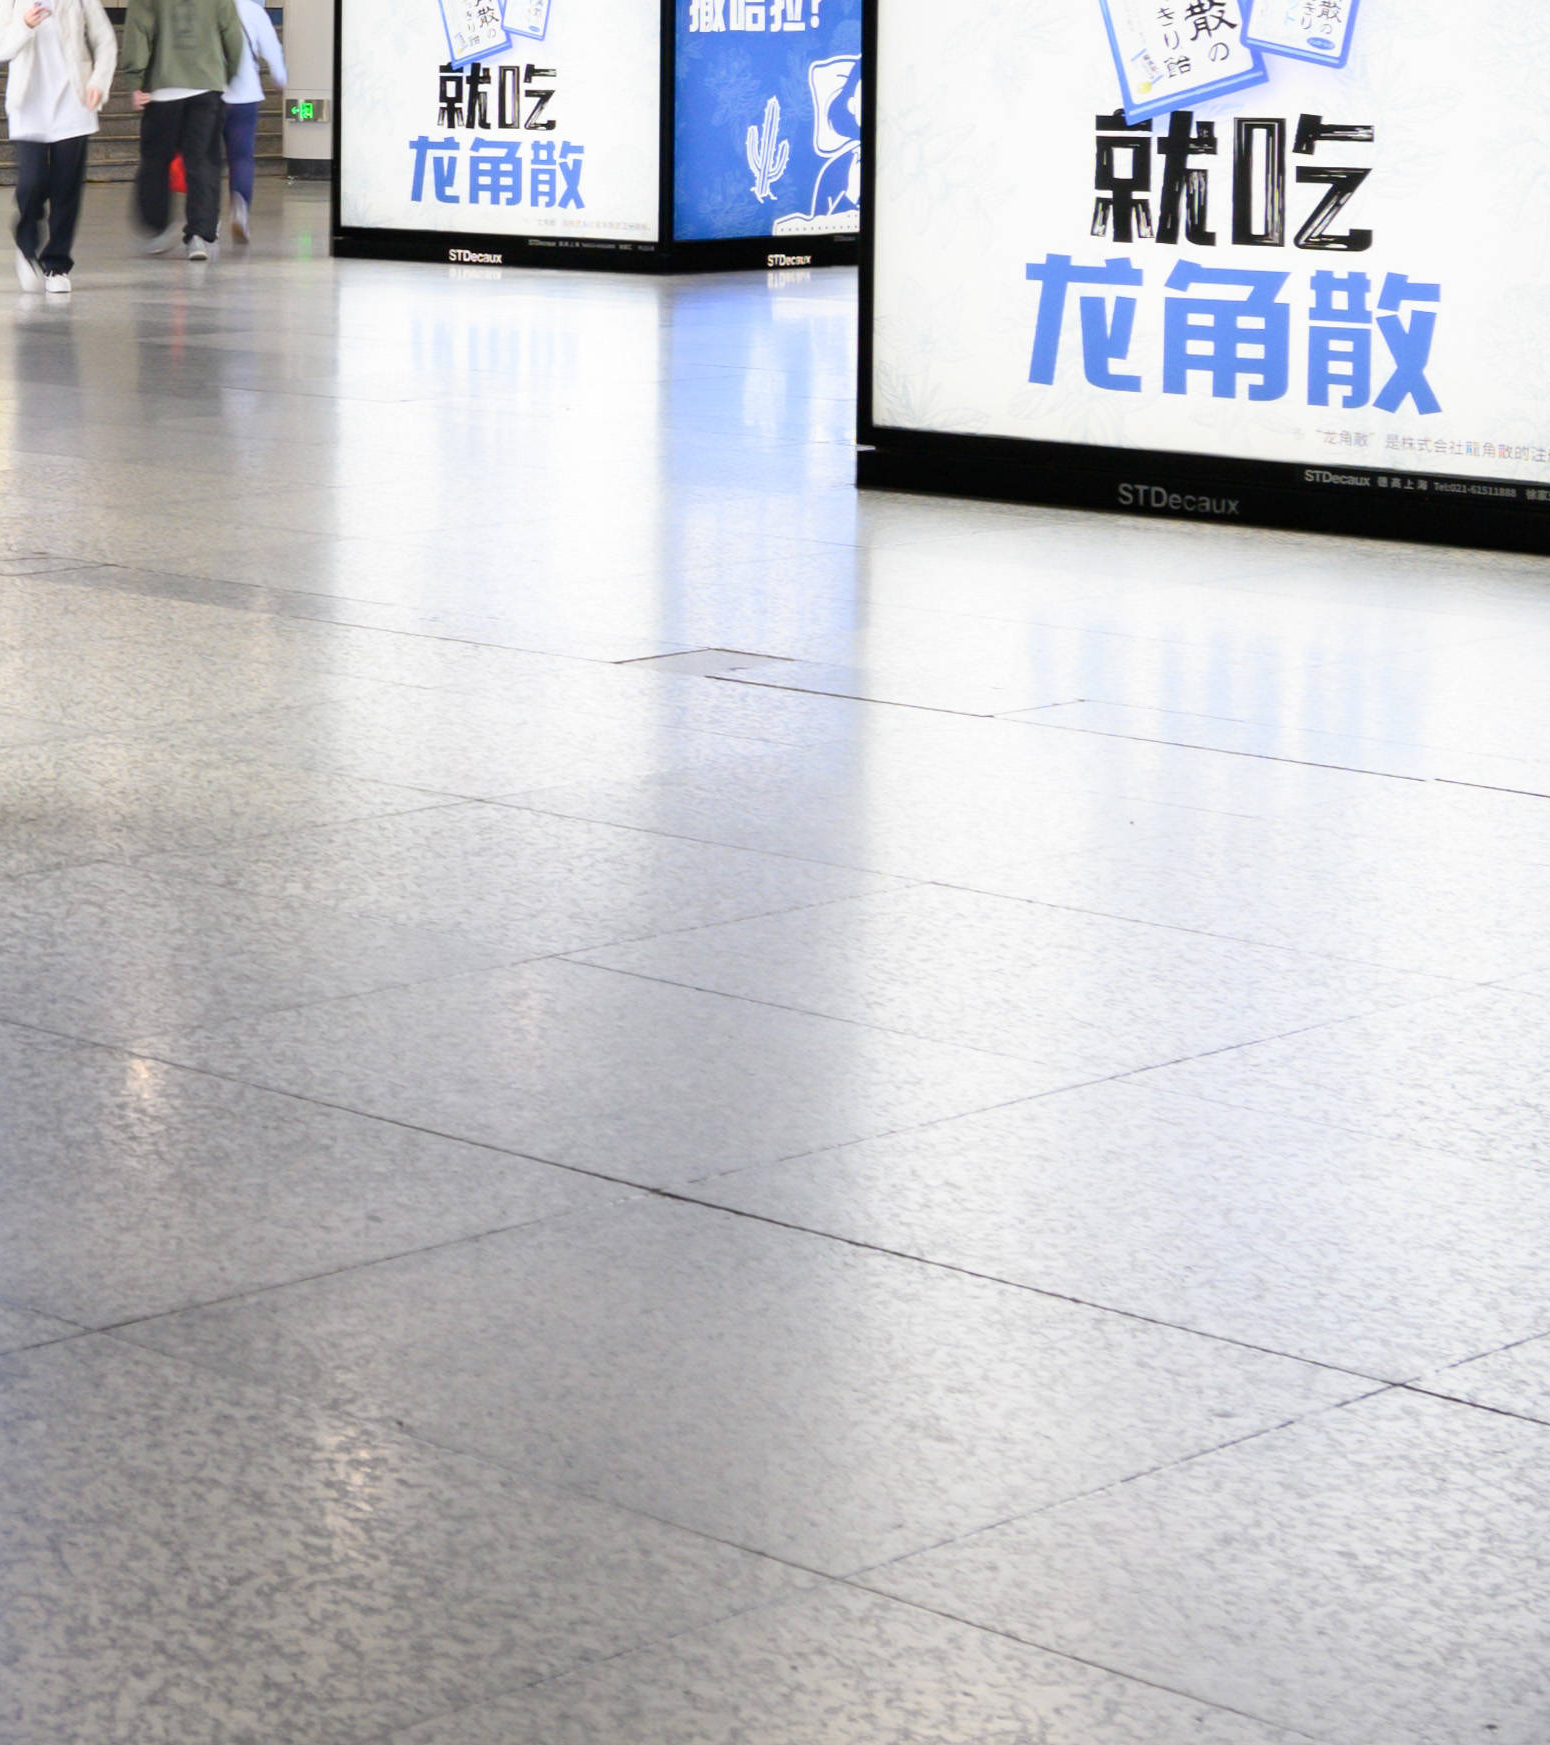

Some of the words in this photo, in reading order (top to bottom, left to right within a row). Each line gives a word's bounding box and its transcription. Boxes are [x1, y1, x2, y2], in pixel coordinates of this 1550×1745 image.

[437, 61, 558, 131] 就吃
[409, 136, 585, 211] 龙角散
[1090, 109, 1376, 252] 就吃
[448, 248, 503, 264] STDecaux
[1024, 252, 1444, 417] 龙角散
[1117, 481, 1240, 516] STDecaux
[1304, 468, 1371, 488] STDecaux
